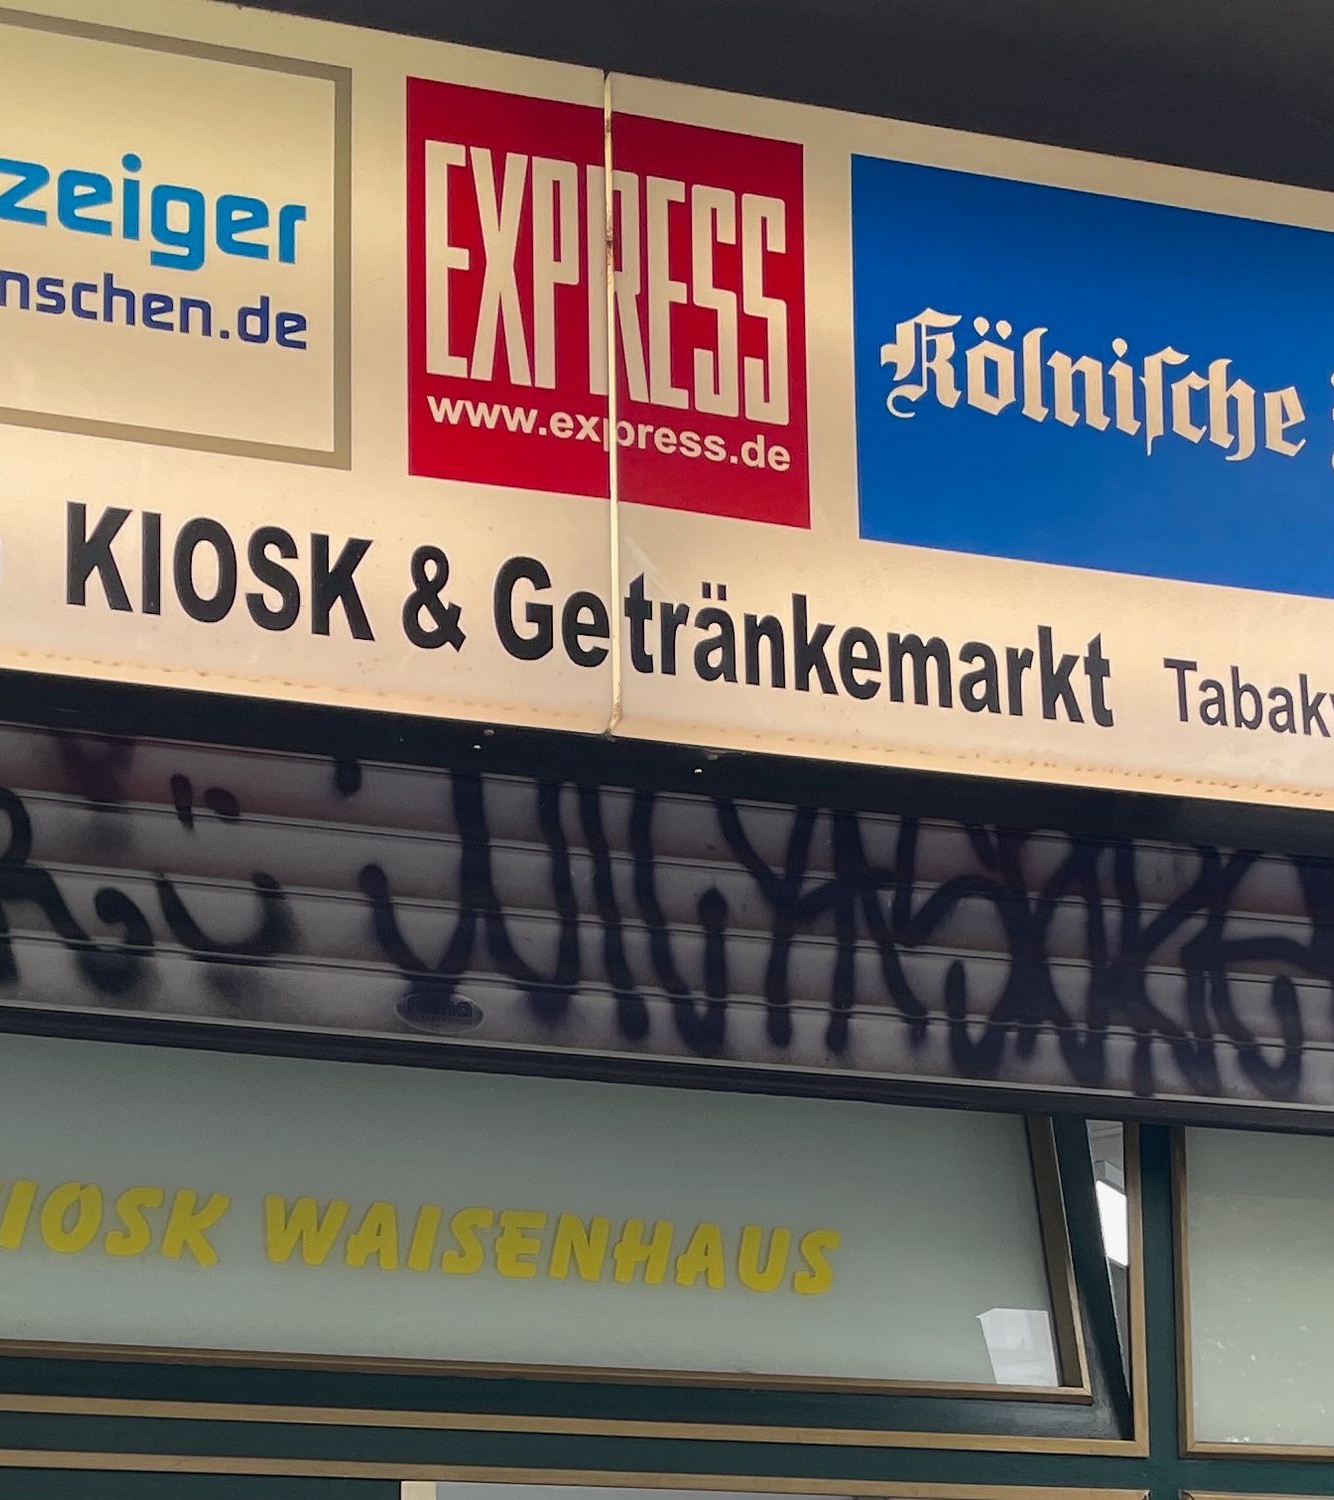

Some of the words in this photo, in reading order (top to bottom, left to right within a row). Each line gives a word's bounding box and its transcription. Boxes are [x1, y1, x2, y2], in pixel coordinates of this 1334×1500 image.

[424, 139, 789, 426] EXPRESS
[427, 395, 790, 472] www.express.de
[67, 501, 375, 642] KIOSK
[403, 546, 466, 653] &
[494, 556, 1115, 728] Getränkemarkt
[265, 1195, 843, 1297] WAISENHAUS
